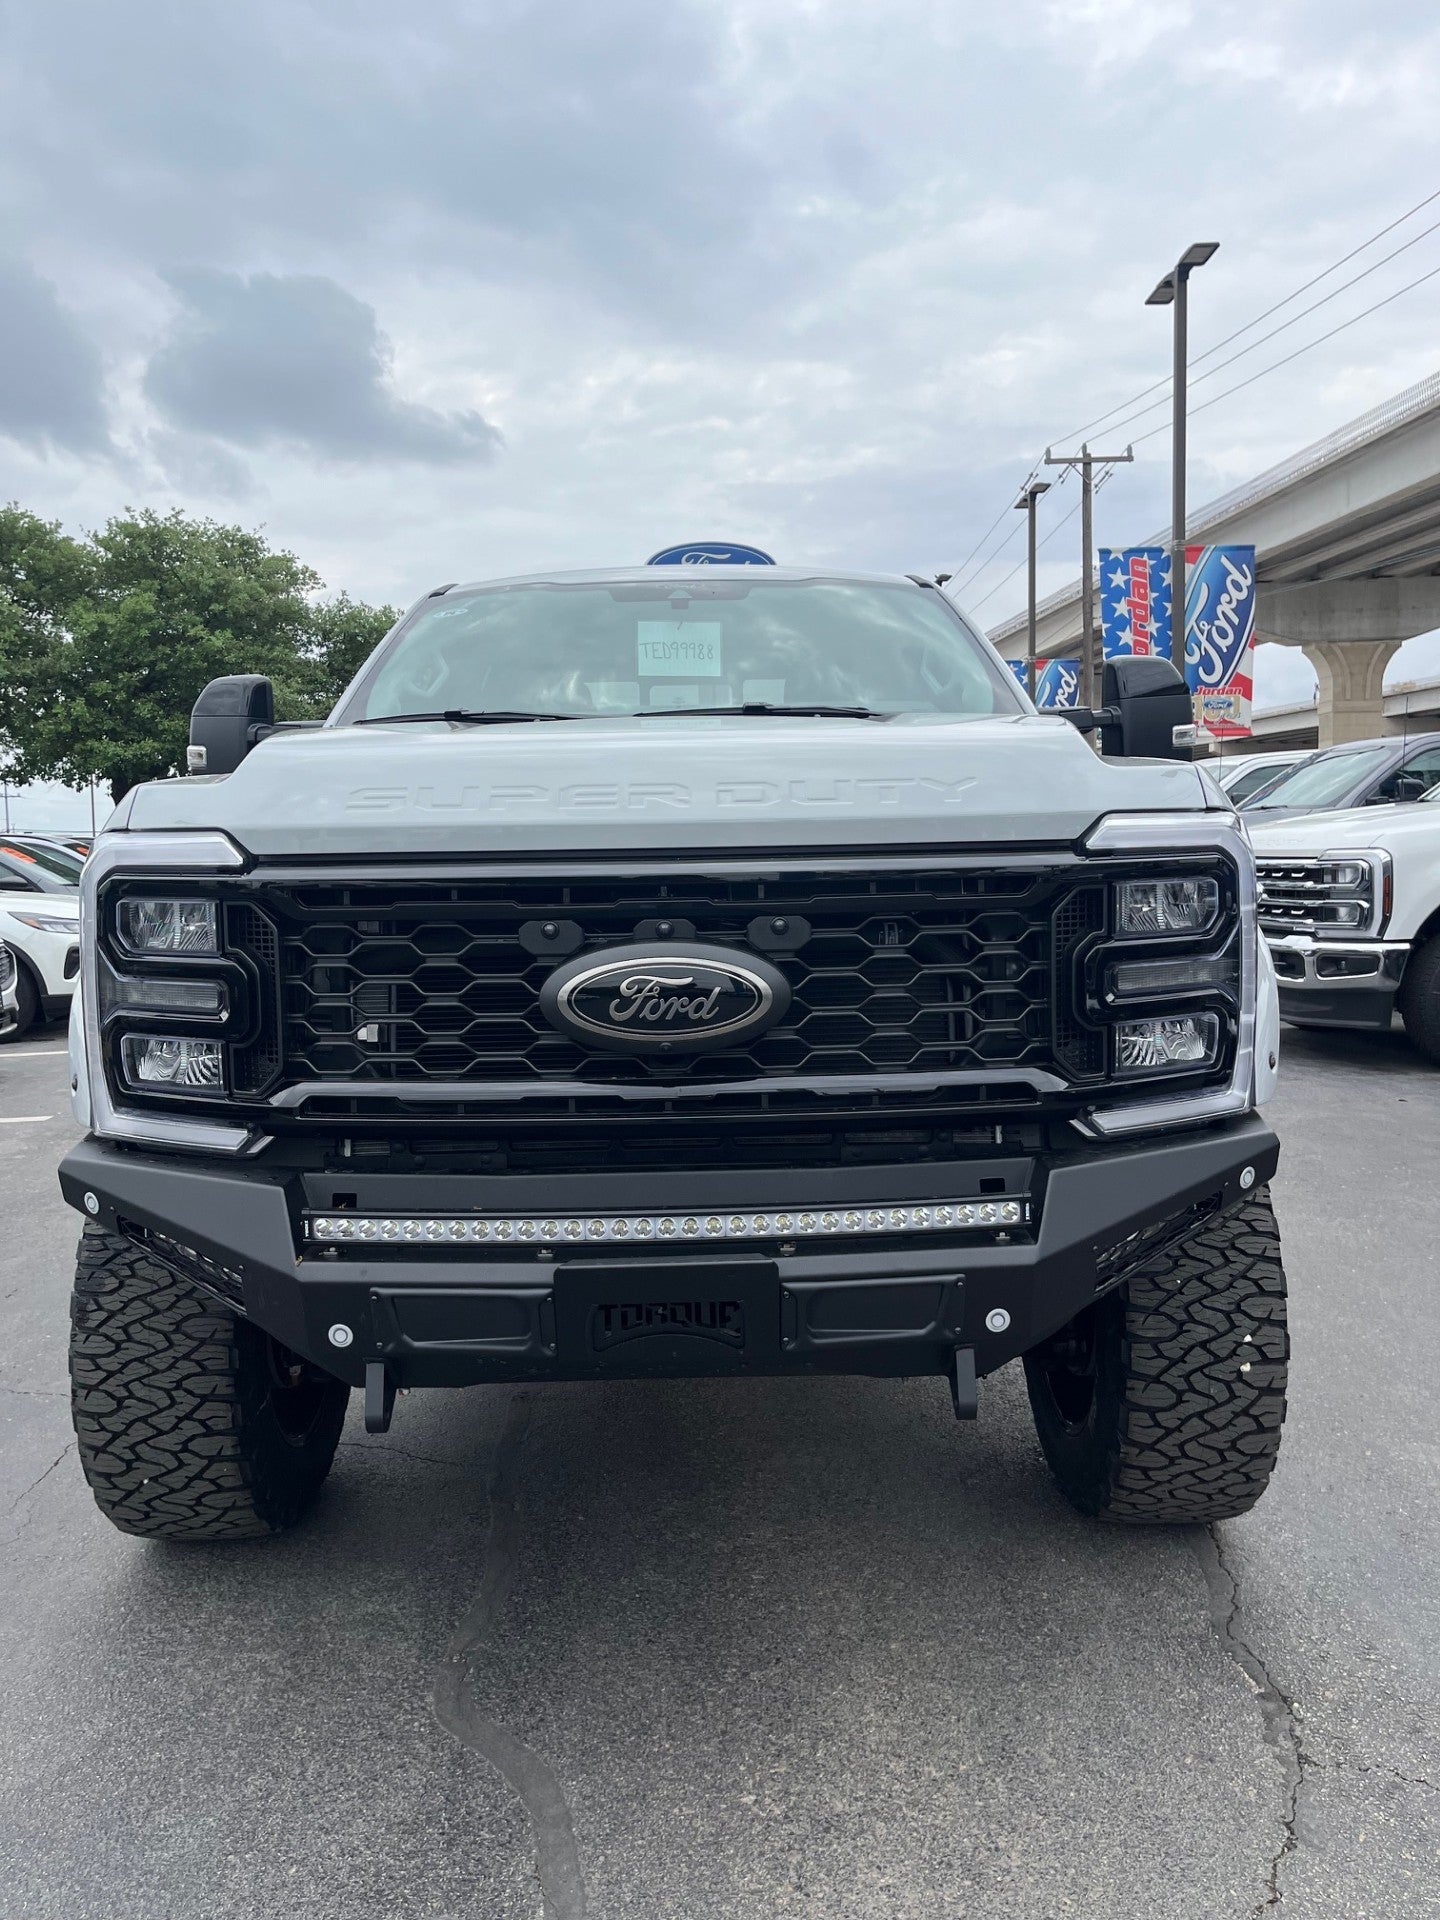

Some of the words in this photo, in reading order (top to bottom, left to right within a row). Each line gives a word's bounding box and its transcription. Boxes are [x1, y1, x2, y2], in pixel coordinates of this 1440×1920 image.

[1127, 556, 1150, 656] ordan
[1185, 554, 1252, 684] Ford
[639, 641, 714, 660] TED99988
[1195, 684, 1243, 696] Jordan
[345, 783, 691, 812] SUPER
[715, 776, 978, 807] DUTY
[608, 975, 722, 1022] Ford
[596, 1301, 744, 1338] TORQUE
